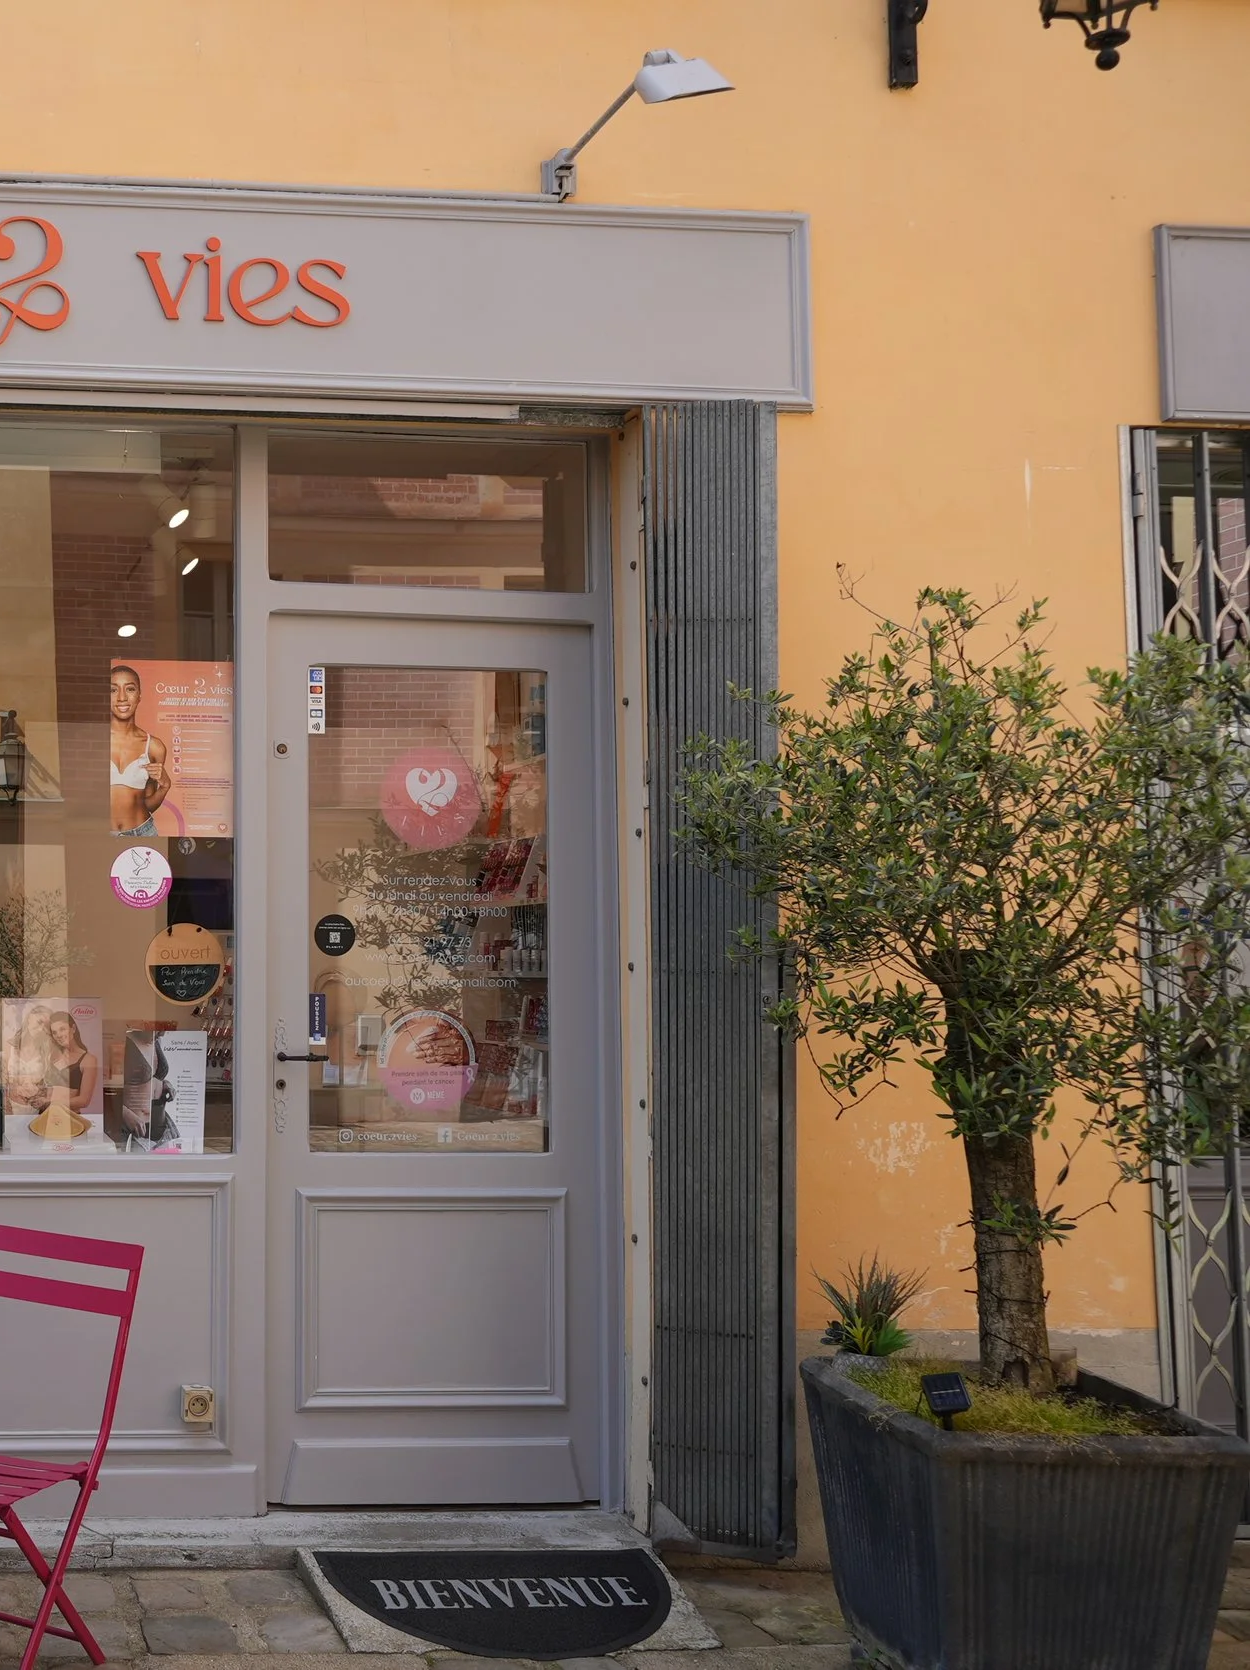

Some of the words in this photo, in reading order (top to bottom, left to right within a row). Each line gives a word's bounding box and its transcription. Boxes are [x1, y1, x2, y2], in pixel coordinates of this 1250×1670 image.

[137, 236, 352, 328] vies
[193, 678, 207, 697] 2
[209, 683, 233, 695] vies
[382, 874, 401, 887] Sur
[402, 875, 477, 887] rendez-vous
[367, 890, 382, 901] du
[419, 892, 435, 901] au
[439, 891, 494, 902] vendredi
[160, 945, 211, 960] ouvert
[72, 1007, 94, 1015] Anita
[369, 1575, 649, 1611] BIENVENUE
